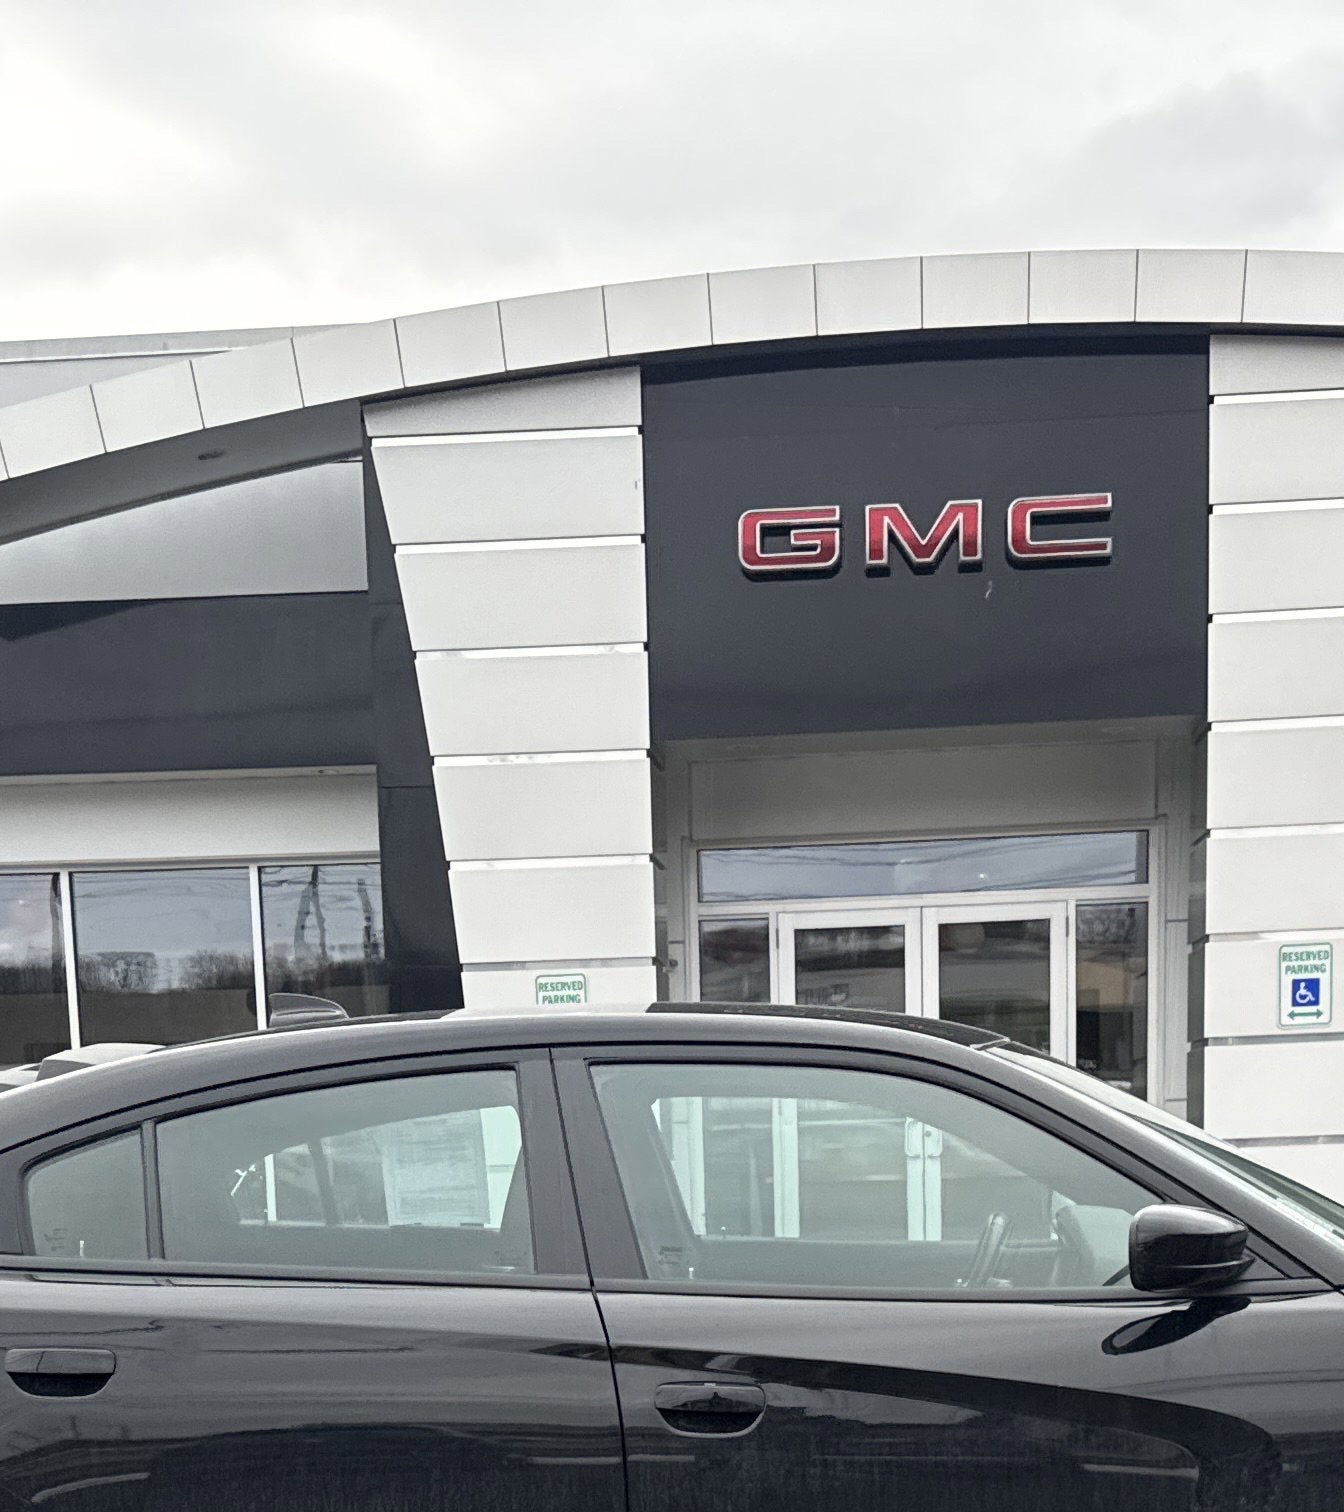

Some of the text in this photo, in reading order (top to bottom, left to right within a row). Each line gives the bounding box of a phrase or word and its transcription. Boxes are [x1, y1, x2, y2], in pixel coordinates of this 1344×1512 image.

[738, 492, 1113, 573] GMC
[1282, 950, 1330, 962] RESERVED
[1285, 963, 1327, 975] PARKING
[538, 981, 583, 993] RESERVED
[542, 994, 581, 1004] PARKING
